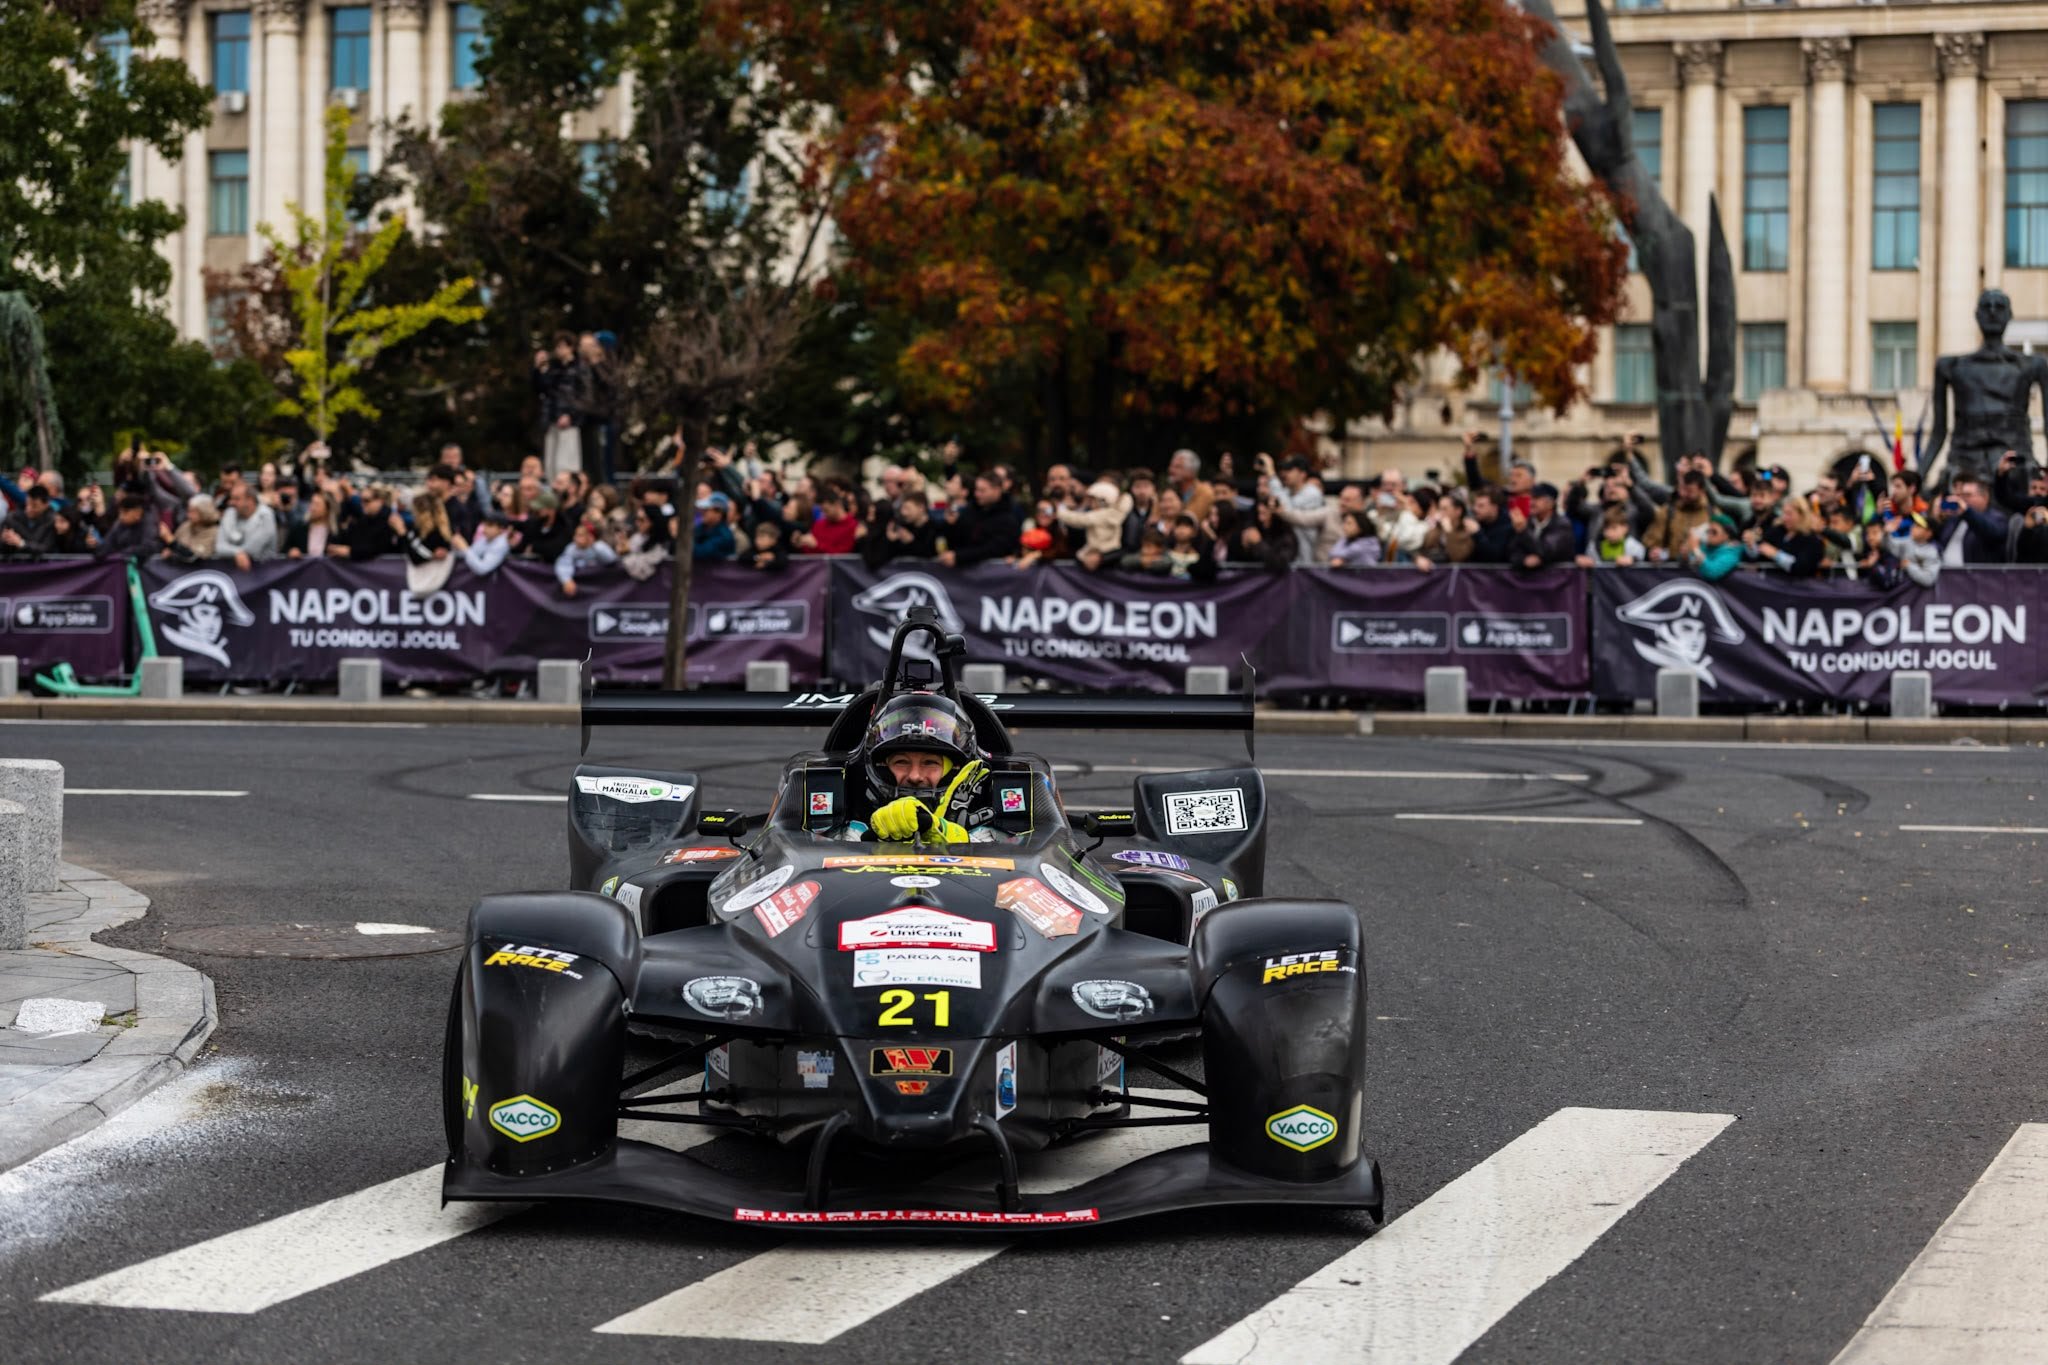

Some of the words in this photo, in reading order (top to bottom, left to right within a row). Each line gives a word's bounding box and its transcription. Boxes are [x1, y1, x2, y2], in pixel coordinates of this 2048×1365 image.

[270, 588, 486, 626] NAPOLEON
[979, 597, 1217, 639] NAPOLEON
[1763, 604, 2026, 646] NAPOLEON
[289, 630, 313, 648] TU
[315, 630, 398, 648] CONDUCI
[400, 631, 460, 650] JOCUL
[1004, 640, 1031, 657] TU
[1032, 639, 1122, 659] CONDUCI
[1126, 641, 1190, 663] JOCUL
[1788, 650, 1819, 671] TU
[1821, 649, 1921, 672] CONDUCI
[1928, 649, 1997, 671] JOCUL
[602, 786, 648, 796] MANGALIA
[890, 929, 963, 938] UniCredit
[878, 989, 950, 1027] 21
[499, 1111, 551, 1127] YACCO
[1277, 1122, 1329, 1135] YACCO
